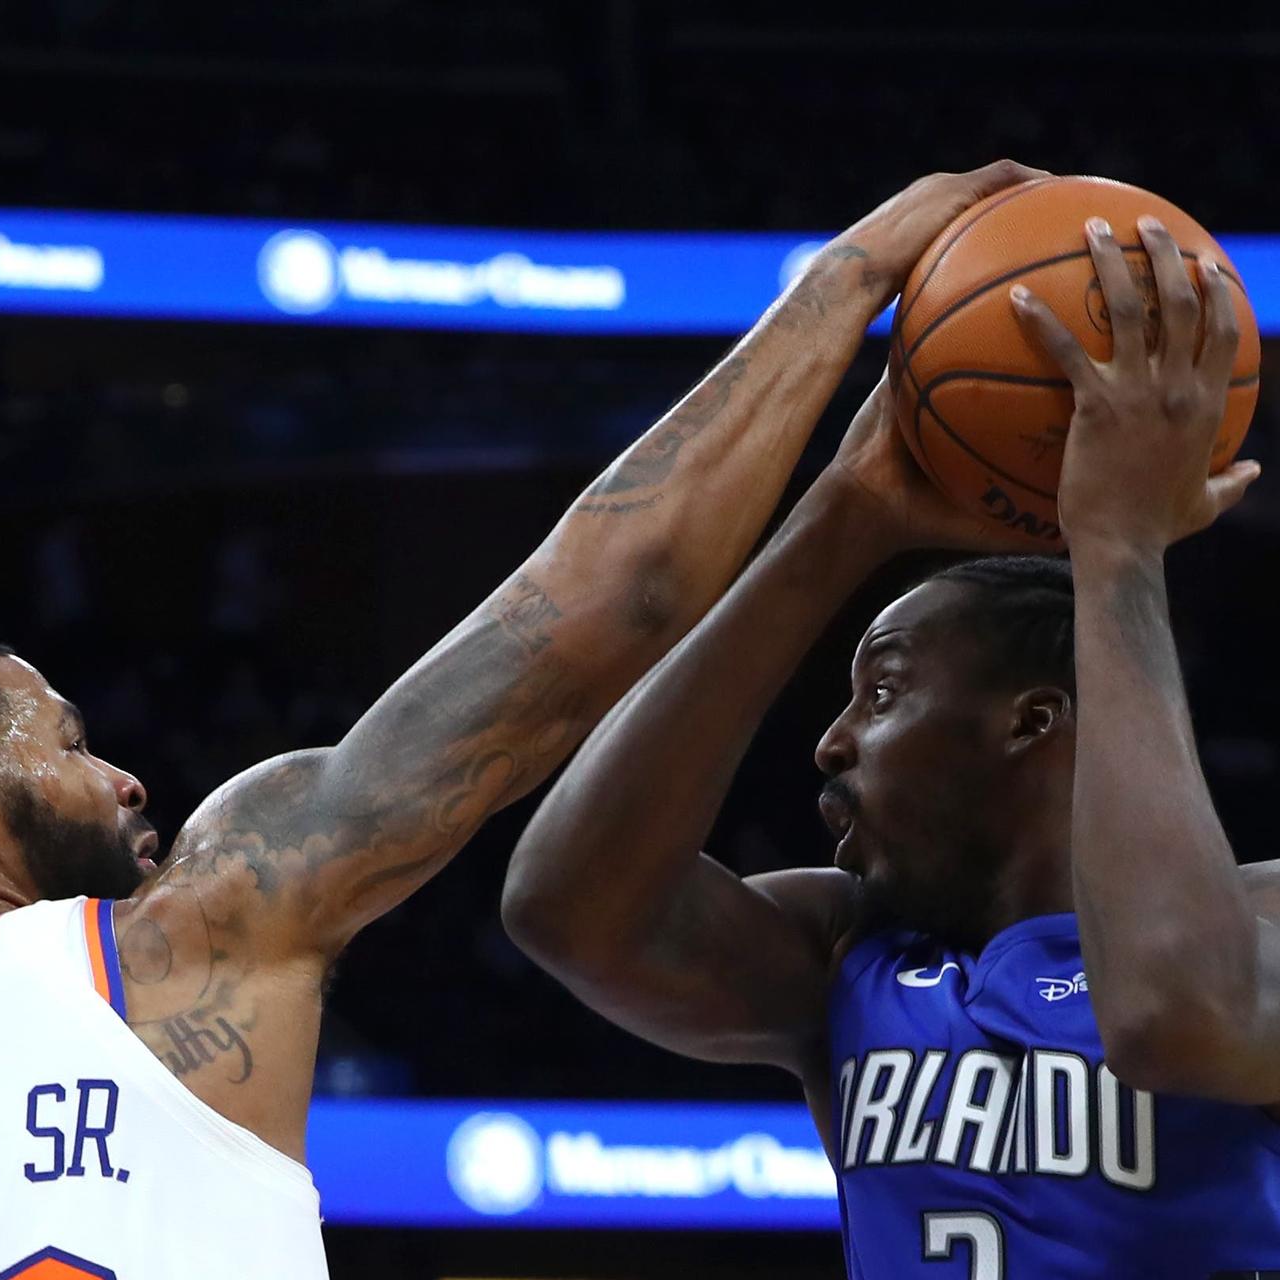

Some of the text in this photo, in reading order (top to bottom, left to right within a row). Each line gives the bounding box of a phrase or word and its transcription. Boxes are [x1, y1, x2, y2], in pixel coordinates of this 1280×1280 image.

[1035, 972, 1089, 1001] Dis
[23, 1078, 130, 1183] SR.
[837, 1047, 1156, 1192] RLADO
